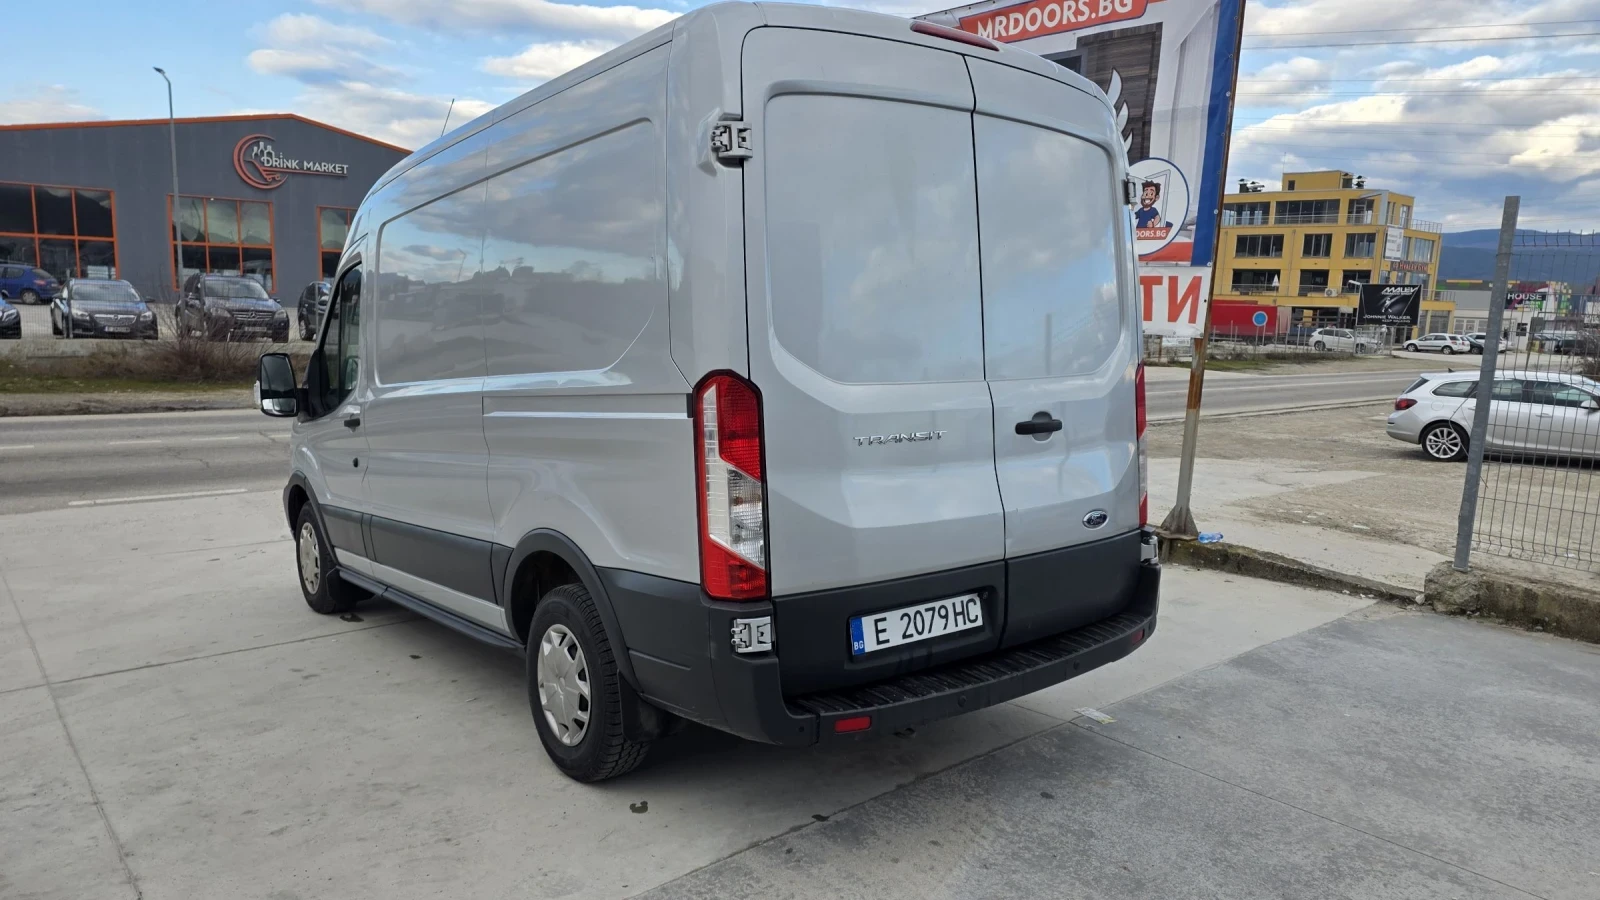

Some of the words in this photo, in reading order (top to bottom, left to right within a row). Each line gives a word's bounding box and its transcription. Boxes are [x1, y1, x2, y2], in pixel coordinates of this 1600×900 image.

[977, 0, 1133, 40] MRDOORS.BG
[303, 160, 348, 174] MARKET
[853, 430, 947, 446] TRANSIT
[874, 617, 890, 646] E
[853, 640, 864, 651] BG
